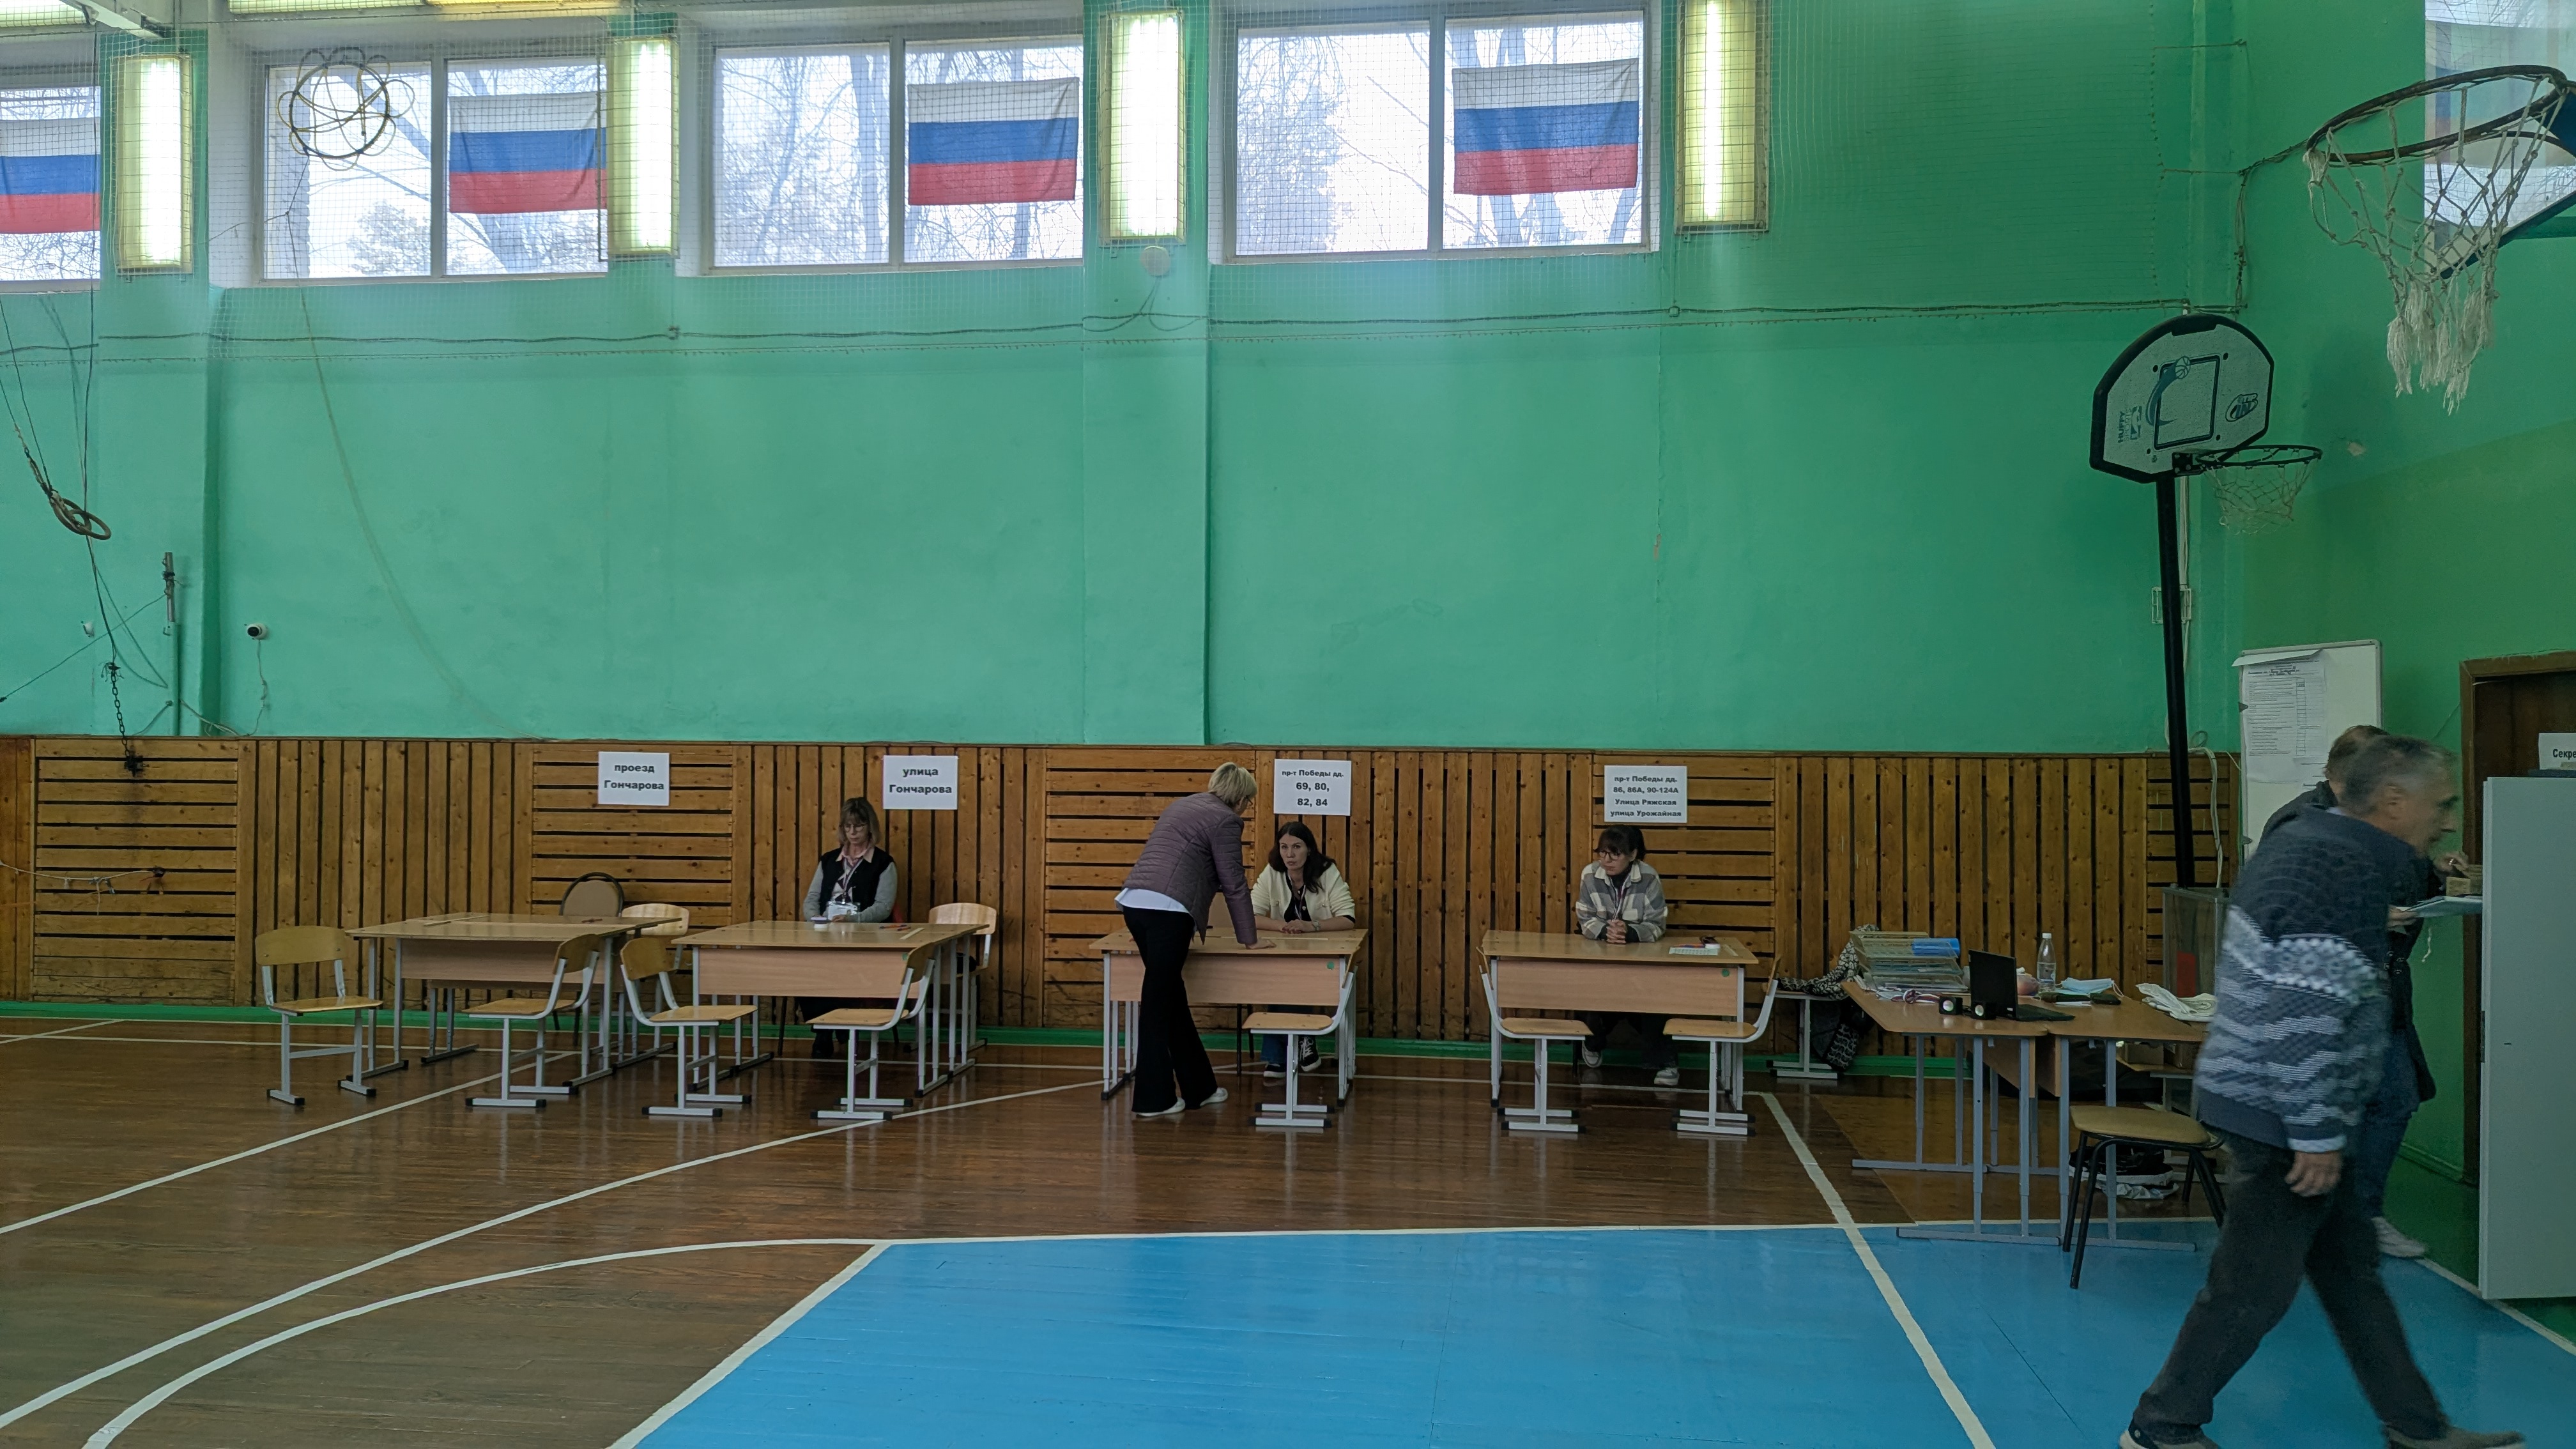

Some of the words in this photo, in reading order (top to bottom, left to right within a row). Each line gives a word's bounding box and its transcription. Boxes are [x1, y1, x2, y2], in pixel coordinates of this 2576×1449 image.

[2123, 408, 2132, 441] SPORTS
[614, 765, 655, 774] проезд
[902, 769, 939, 778] улица
[604, 779, 664, 791] Гончарова
[889, 785, 952, 795] Гончарова
[1296, 782, 1312, 792] 69,
[1314, 783, 1330, 792] 80,
[1297, 798, 1312, 807] 82,
